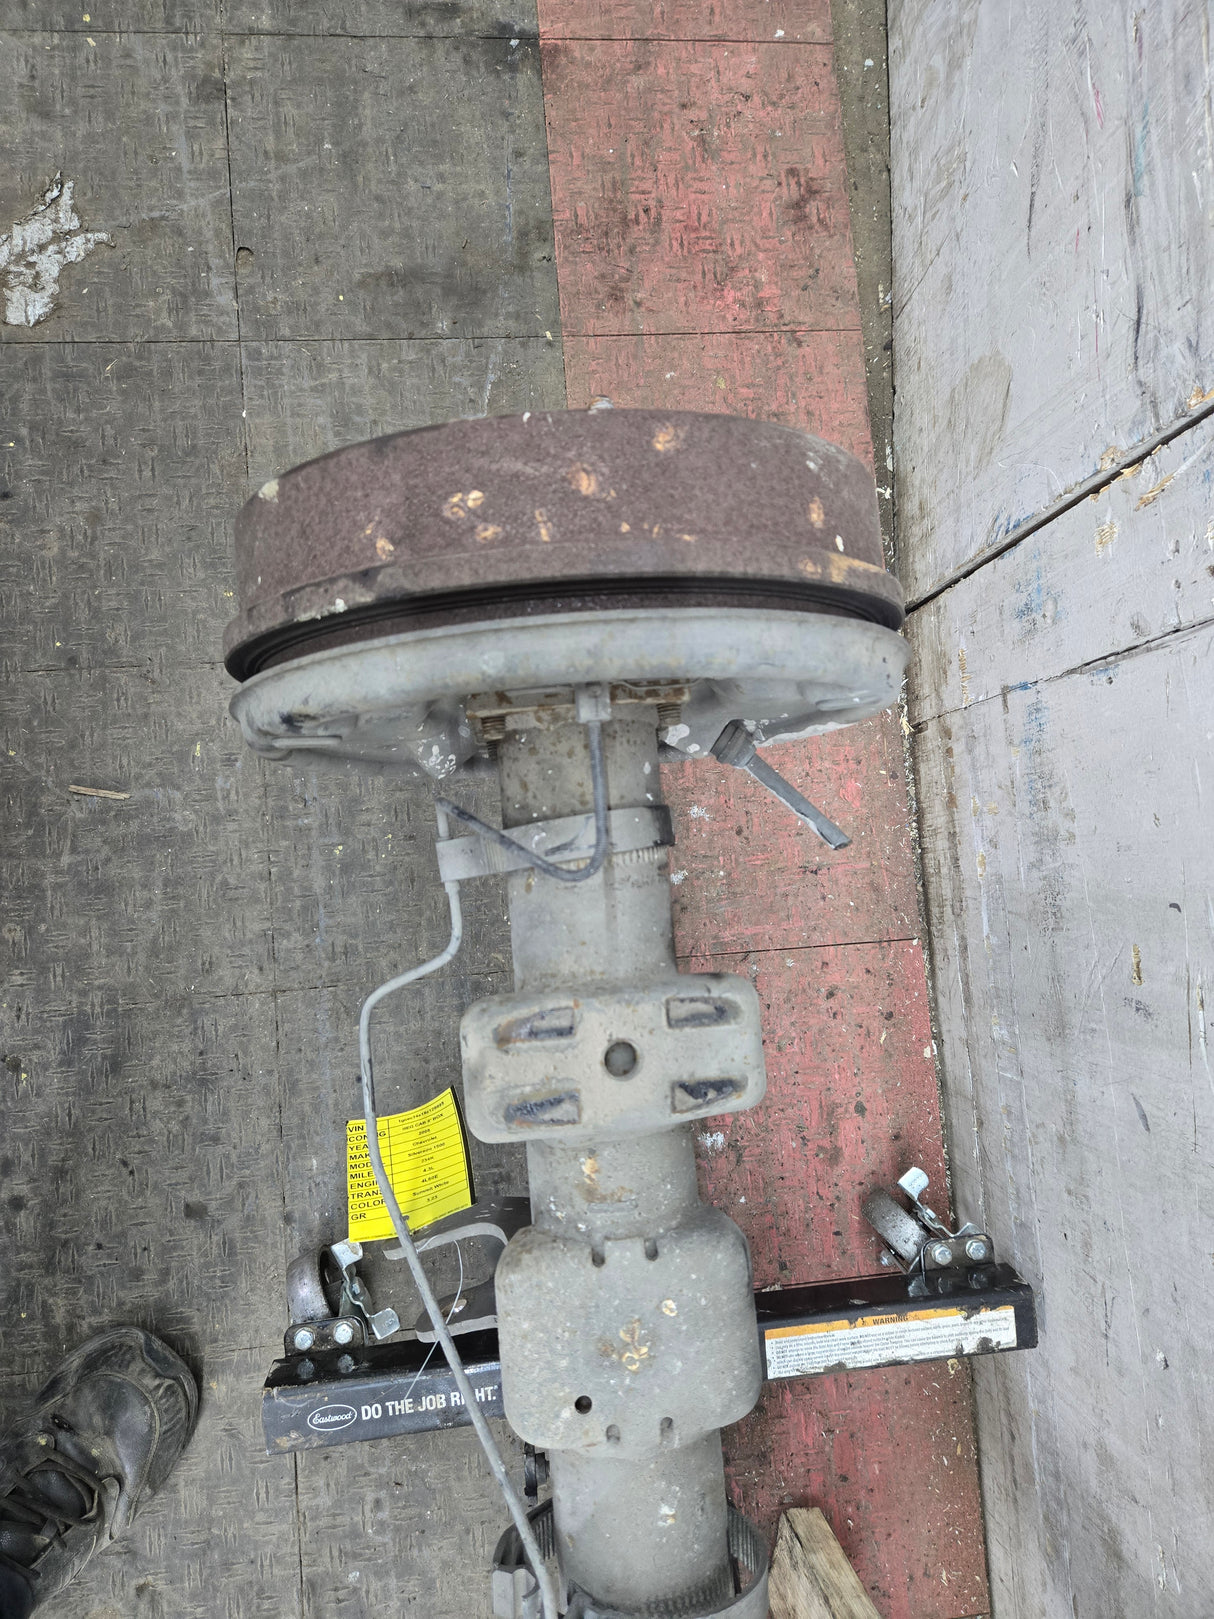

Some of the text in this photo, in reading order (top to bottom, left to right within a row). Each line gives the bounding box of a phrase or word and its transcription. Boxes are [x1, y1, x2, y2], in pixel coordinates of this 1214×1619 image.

[348, 1125, 364, 1133] VIN
[349, 1143, 369, 1151] YEA
[349, 1152, 370, 1161] MAK
[349, 1161, 373, 1170] MOD
[350, 1180, 378, 1190] ENGI
[350, 1189, 382, 1200] TRAN
[350, 1212, 367, 1221] GR
[872, 1315, 909, 1326] WARNING
[360, 1385, 498, 1421] DO THE JOB RIHT.
[311, 1411, 353, 1425] Eastwood
